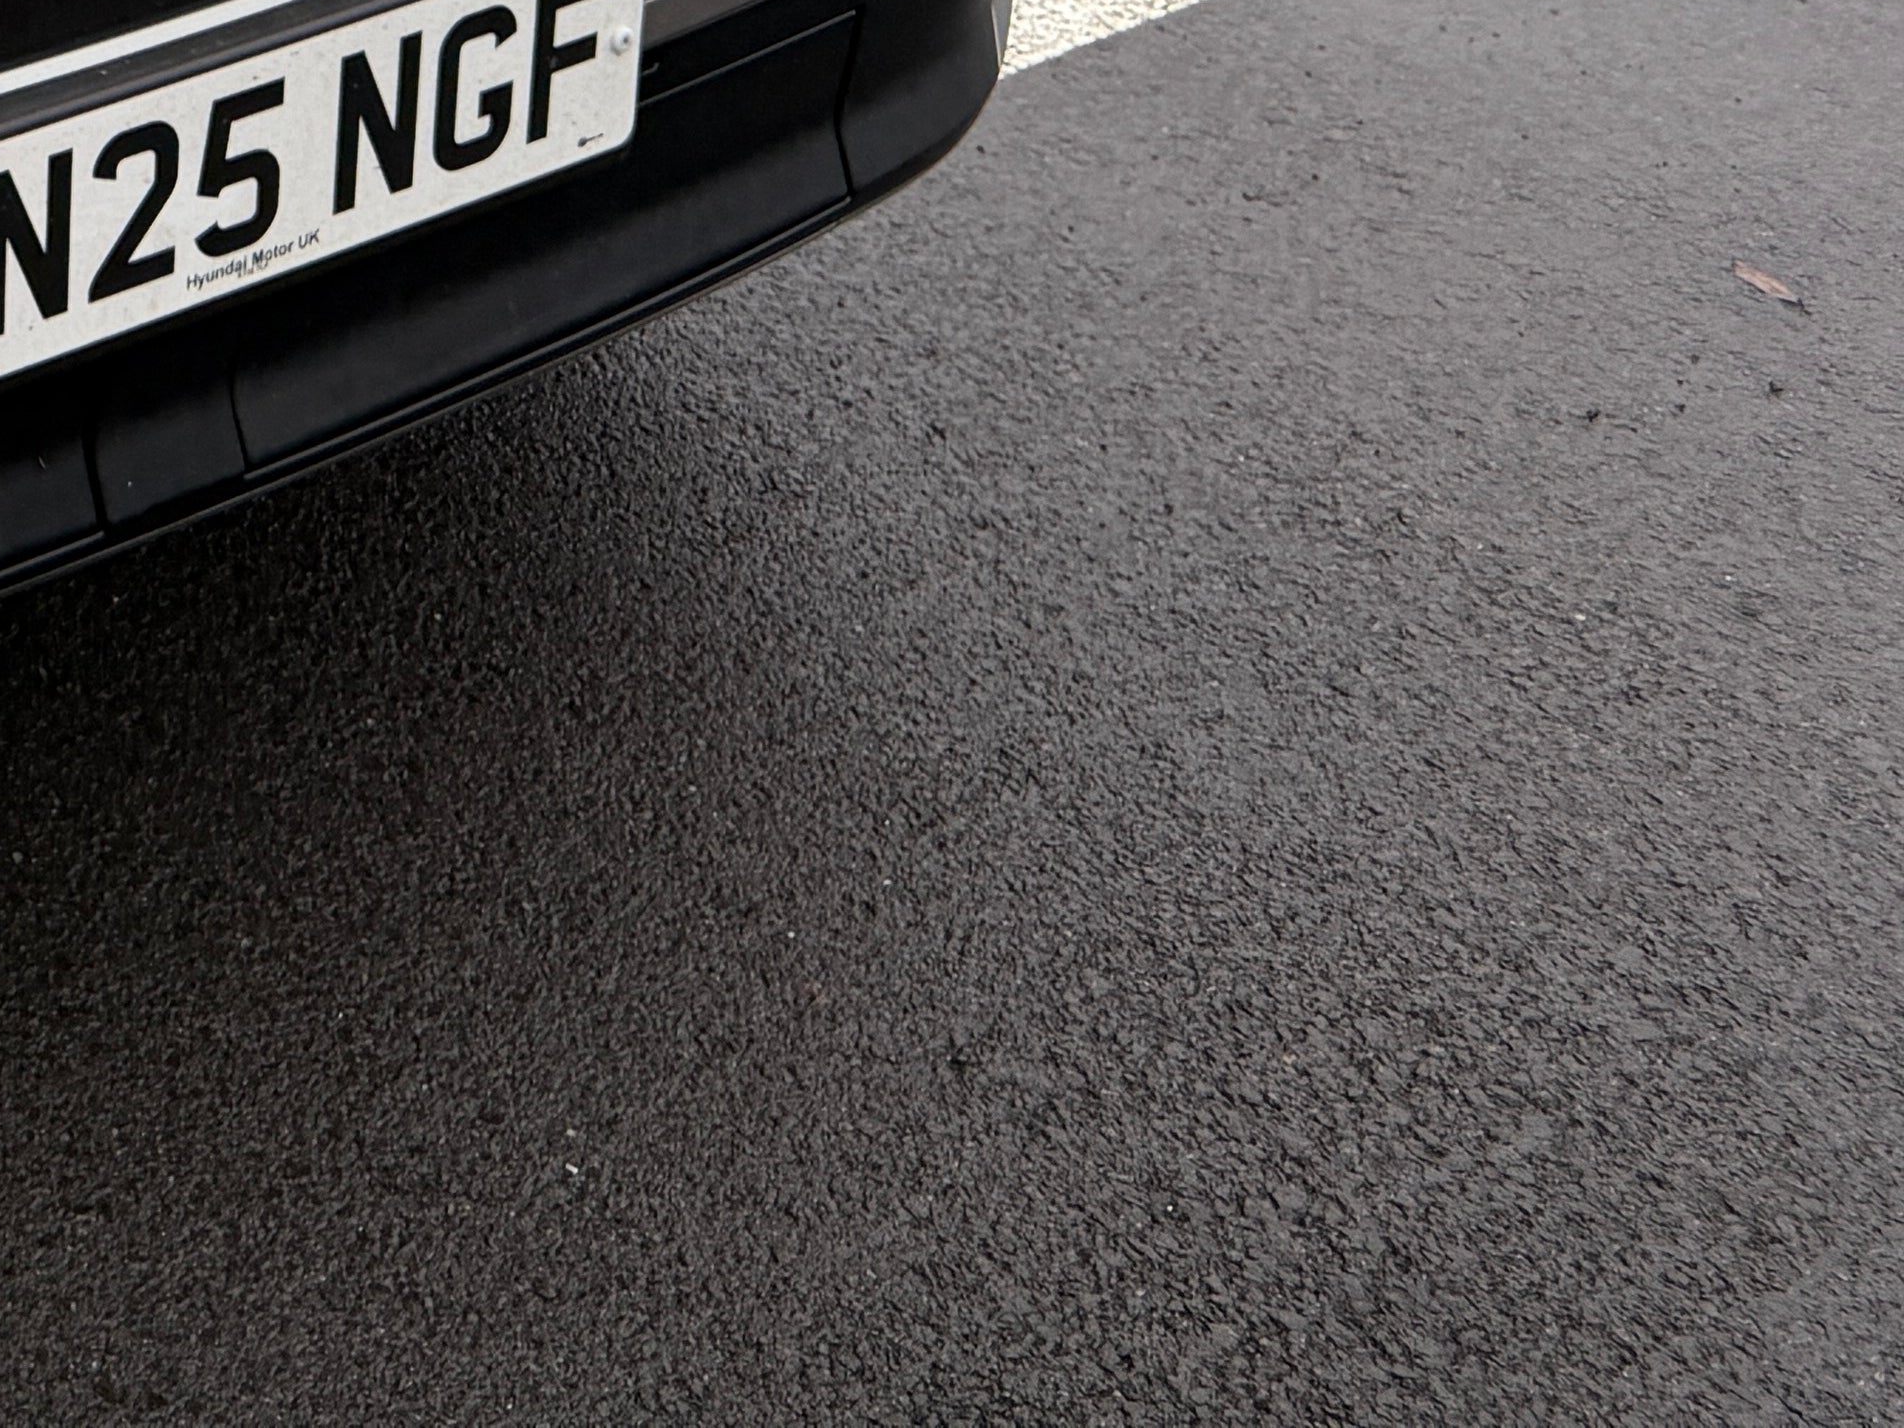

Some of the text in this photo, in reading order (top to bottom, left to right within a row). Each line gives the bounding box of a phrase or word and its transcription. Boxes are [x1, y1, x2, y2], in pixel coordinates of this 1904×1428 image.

[186, 255, 247, 291] Hyundai
[252, 240, 294, 265] Motor
[298, 228, 320, 248] UK
